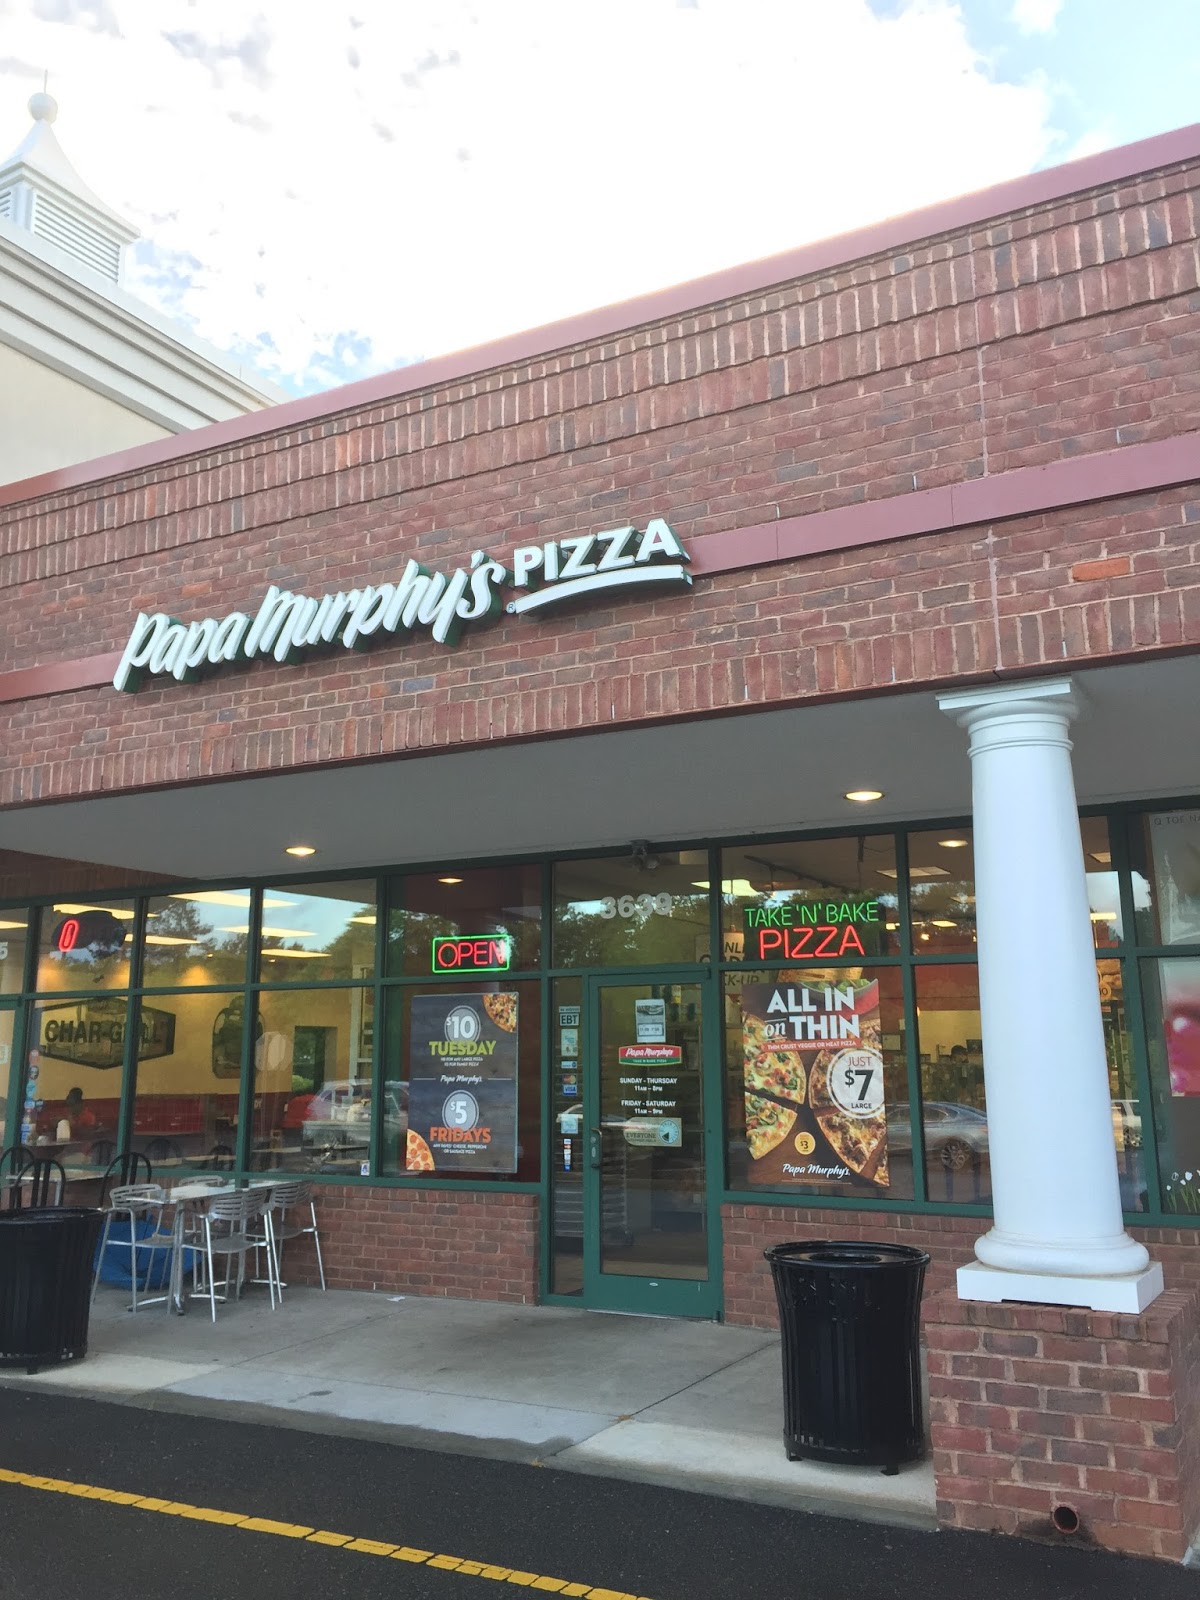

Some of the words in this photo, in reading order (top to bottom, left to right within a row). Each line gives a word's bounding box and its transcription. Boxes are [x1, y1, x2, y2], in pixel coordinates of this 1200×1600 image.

[112, 611, 250, 692] Papa
[244, 550, 506, 664] Murphy's
[513, 517, 686, 587] PIZZA
[600, 892, 672, 919] 3639
[744, 905, 793, 928] TAKE
[826, 901, 879, 924] BAKE
[437, 940, 504, 967] OPEN
[758, 925, 865, 960] PIZZA
[767, 988, 817, 1013] ALL
[824, 986, 855, 1011] IN
[445, 1015, 476, 1039] $10
[561, 1014, 579, 1024] EBT
[764, 1022, 786, 1037] on
[788, 1014, 860, 1040] THIN
[428, 1040, 497, 1056] TUESDAY
[848, 1056, 872, 1067] JUST
[647, 1077, 678, 1085] THURSDAY
[844, 1067, 874, 1101] $7
[450, 1100, 468, 1124] $5
[429, 1126, 492, 1144] FRIDAYS
[782, 1163, 806, 1177] Papa
